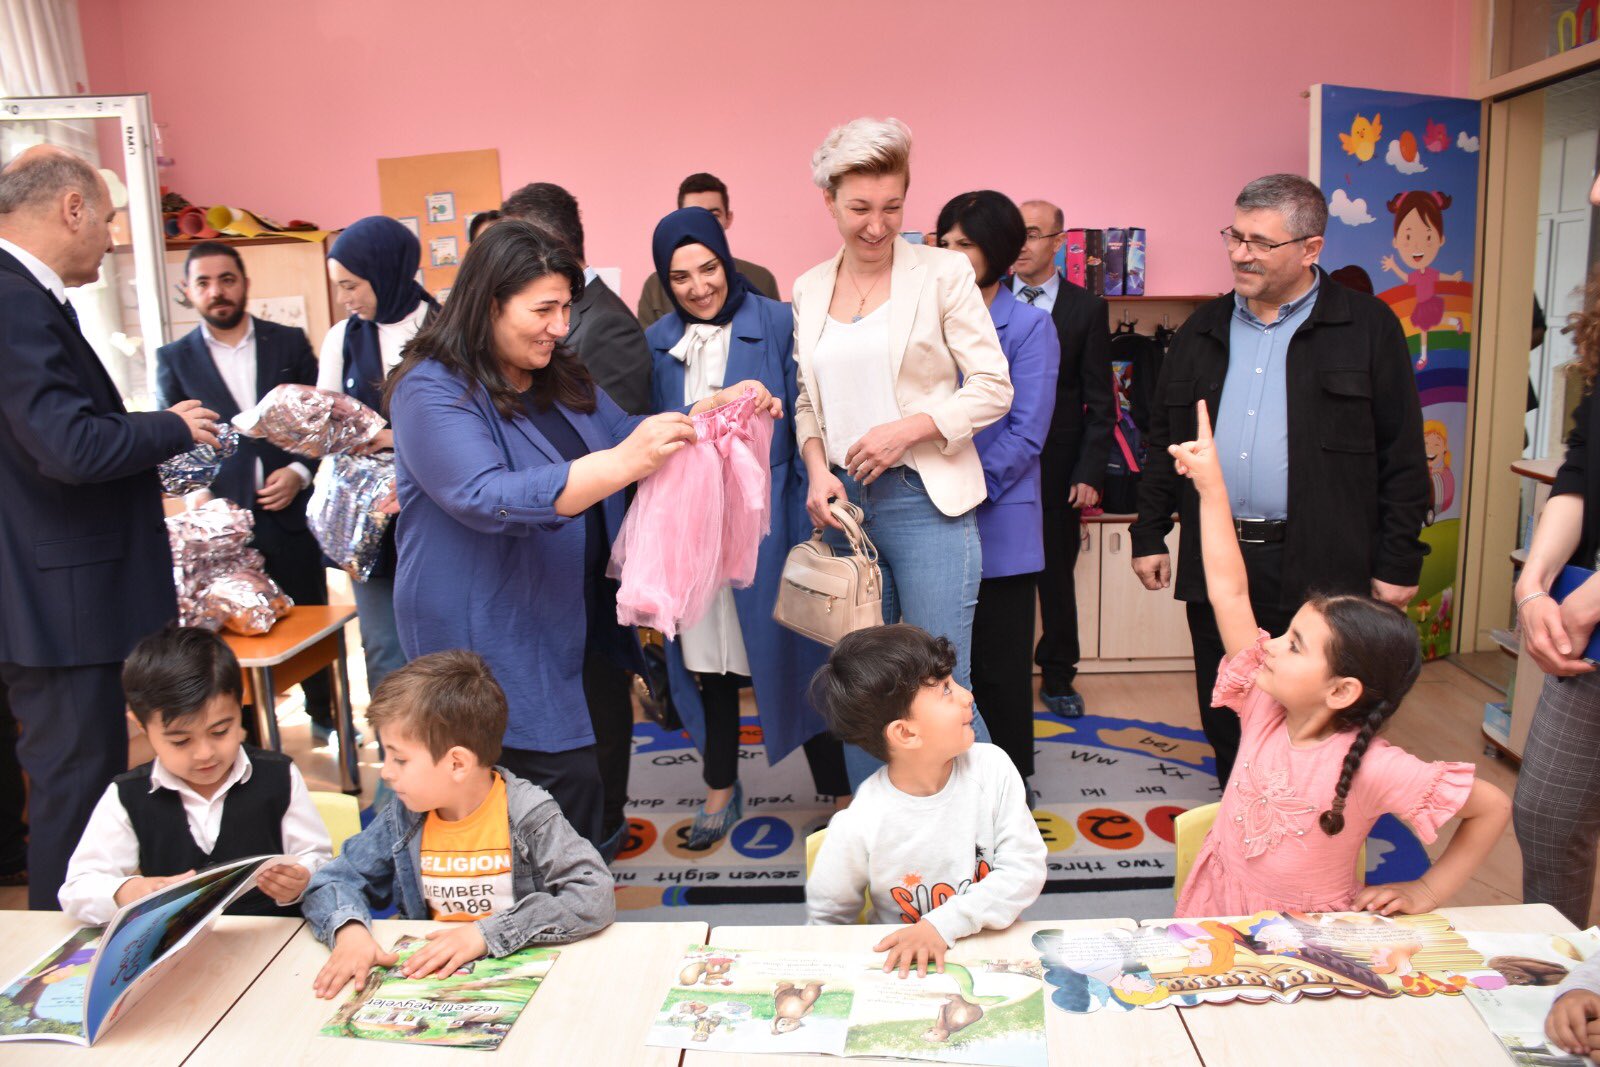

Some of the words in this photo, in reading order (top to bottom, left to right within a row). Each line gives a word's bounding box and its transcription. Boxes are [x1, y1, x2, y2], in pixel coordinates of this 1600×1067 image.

[1139, 736, 1179, 753] bej
[748, 796, 795, 807] yedi
[1086, 815, 1133, 840] 2
[743, 823, 778, 849] 7
[1117, 858, 1165, 869] two
[653, 869, 720, 884] eight
[728, 870, 800, 880] seven
[424, 884, 495, 899] MEMBER
[441, 898, 493, 915] 1989
